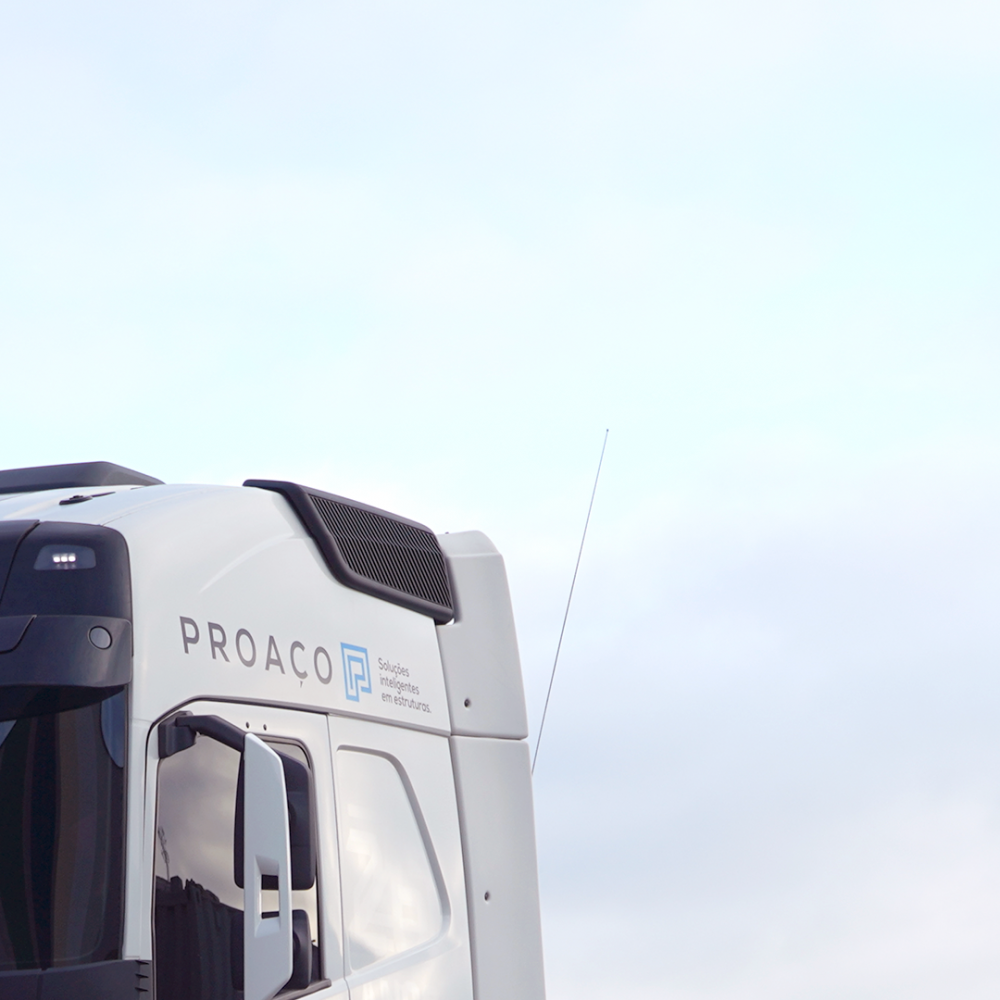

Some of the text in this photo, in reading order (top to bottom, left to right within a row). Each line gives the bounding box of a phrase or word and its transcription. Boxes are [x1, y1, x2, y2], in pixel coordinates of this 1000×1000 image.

[179, 616, 333, 688] PROAÇO
[378, 657, 410, 678] Soluções
[379, 673, 420, 695] inteligentes
[381, 692, 432, 713] em estruturas.
